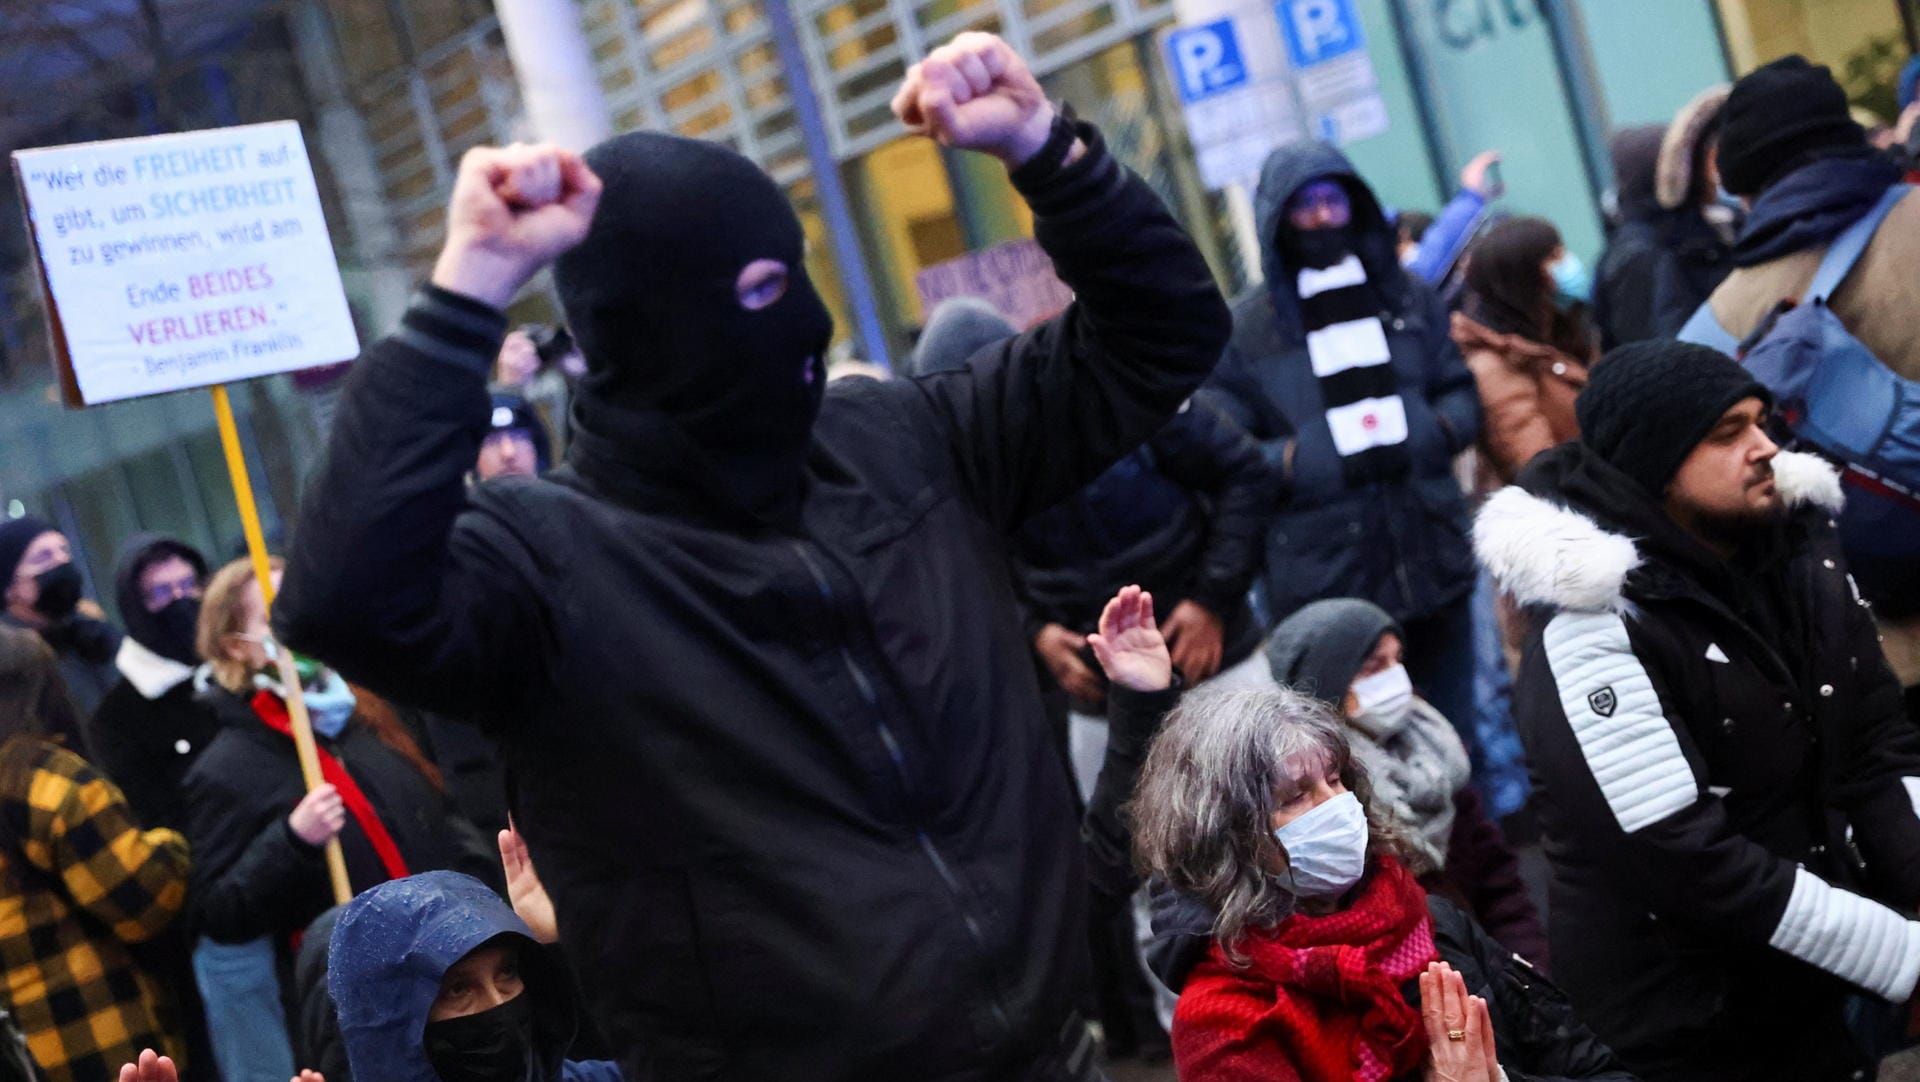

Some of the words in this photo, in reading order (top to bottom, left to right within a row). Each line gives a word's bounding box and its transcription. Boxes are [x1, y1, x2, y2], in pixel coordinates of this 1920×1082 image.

[93, 162, 127, 187] die
[135, 145, 247, 179] FREIHEIT
[53, 206, 105, 238] gibt,
[111, 203, 146, 225] um
[151, 180, 295, 218] SICHERHEIT
[68, 244, 94, 267] zu
[101, 232, 210, 266] gewinnen,
[216, 217, 265, 243] wird
[271, 217, 303, 239] am
[127, 281, 180, 308] Ende
[189, 264, 273, 298] BEIDES
[143, 347, 230, 376] Benjamin
[231, 333, 302, 361] Franklin
